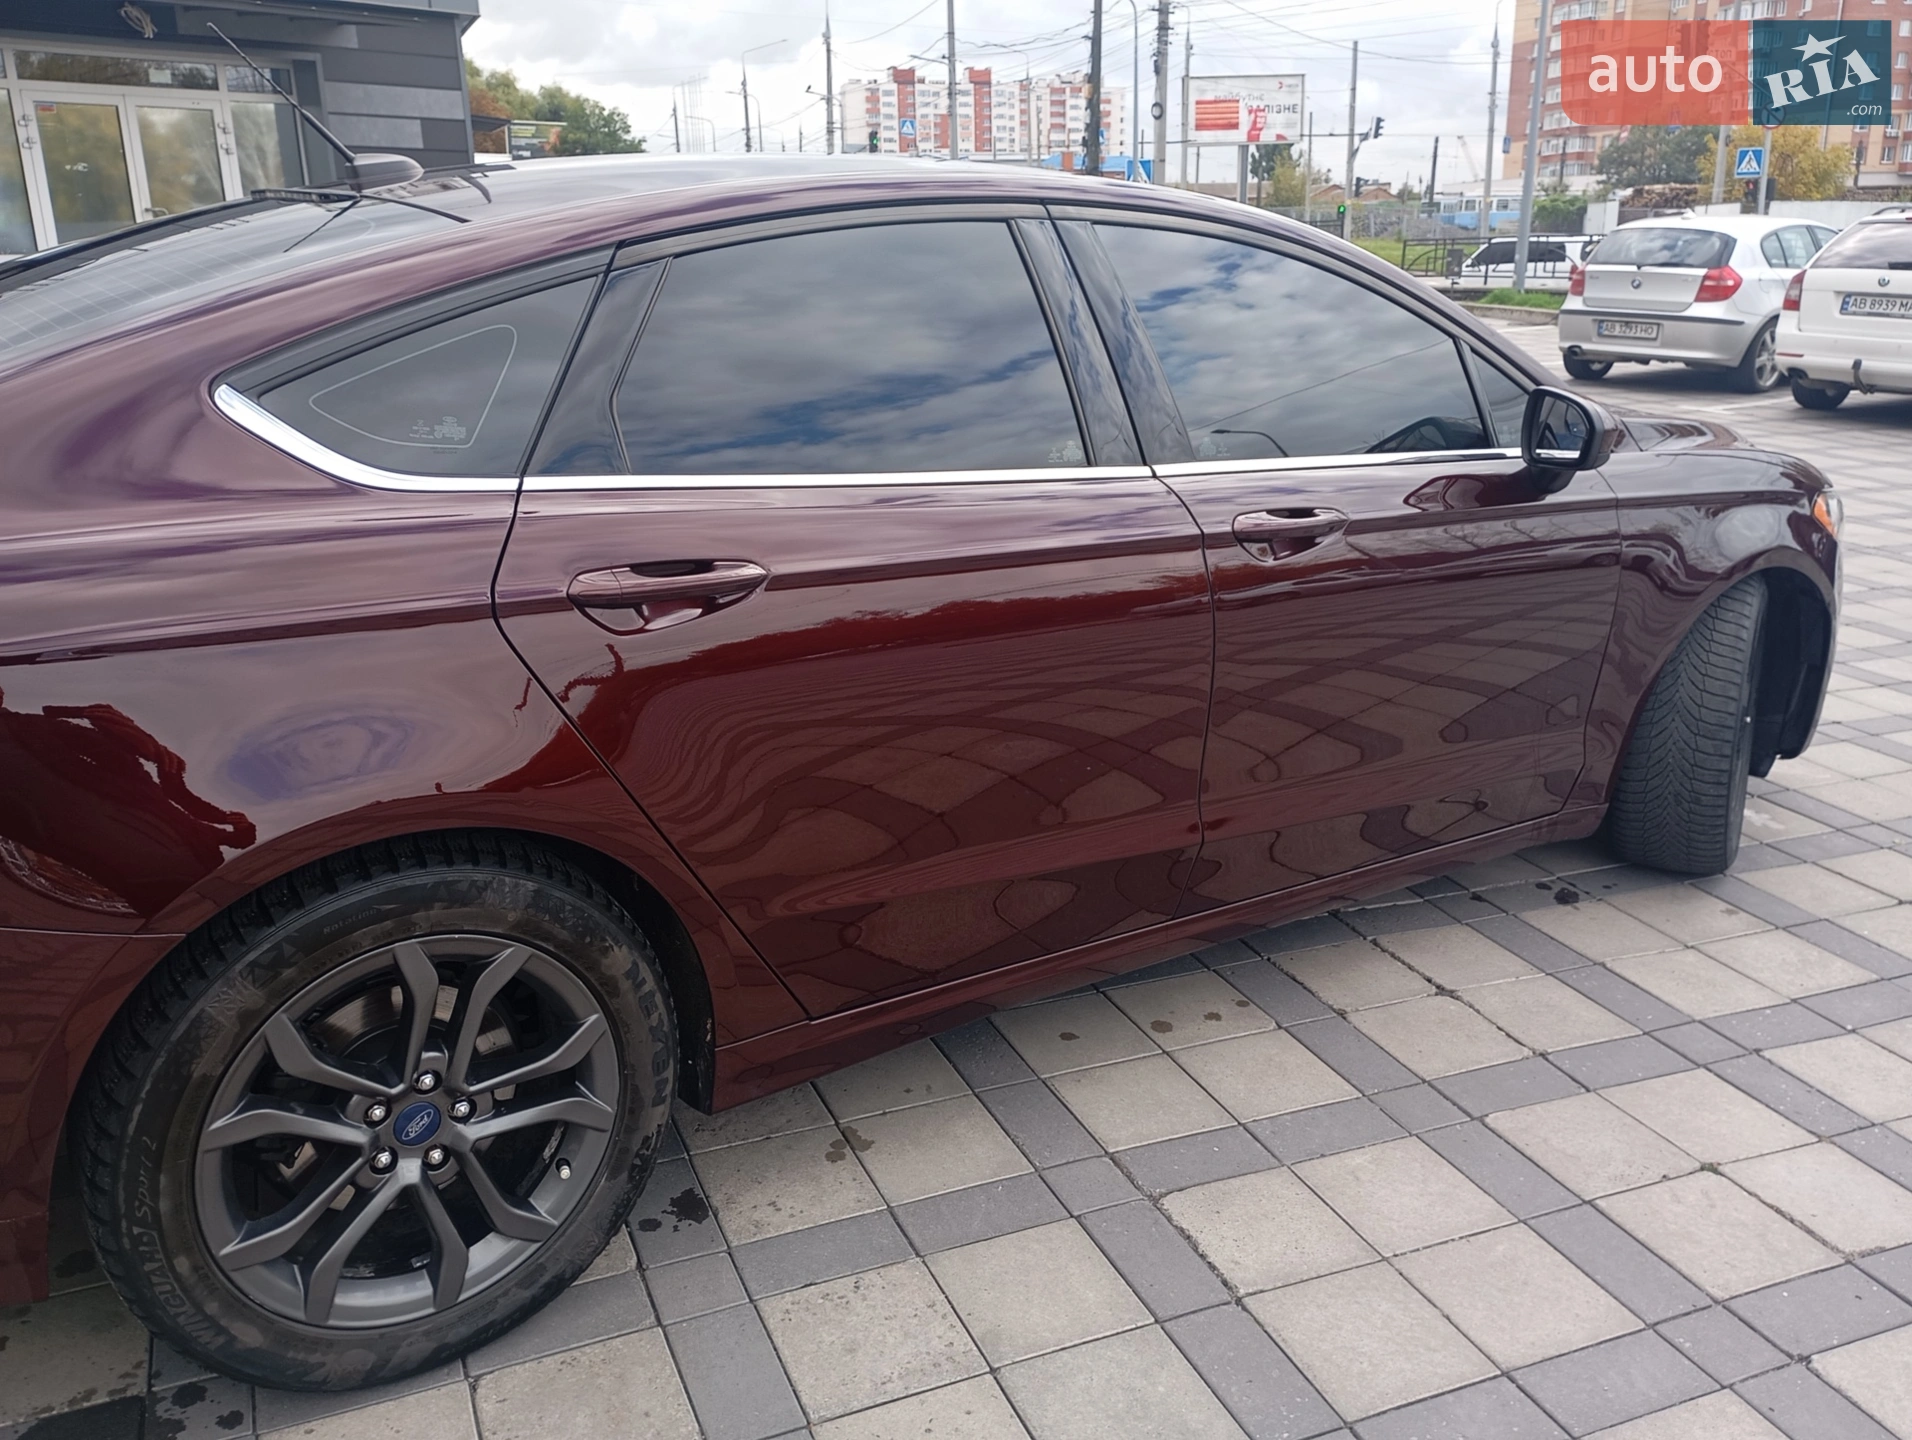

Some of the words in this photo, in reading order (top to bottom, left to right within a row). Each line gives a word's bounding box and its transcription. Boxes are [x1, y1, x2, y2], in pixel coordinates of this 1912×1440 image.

[1849, 297, 1867, 309] AB
[1869, 299, 1897, 312] 8939
[1604, 323, 1616, 333] AB
[323, 907, 377, 935] Rotation
[623, 958, 670, 1108] NEXEN
[407, 1113, 429, 1137] Ford
